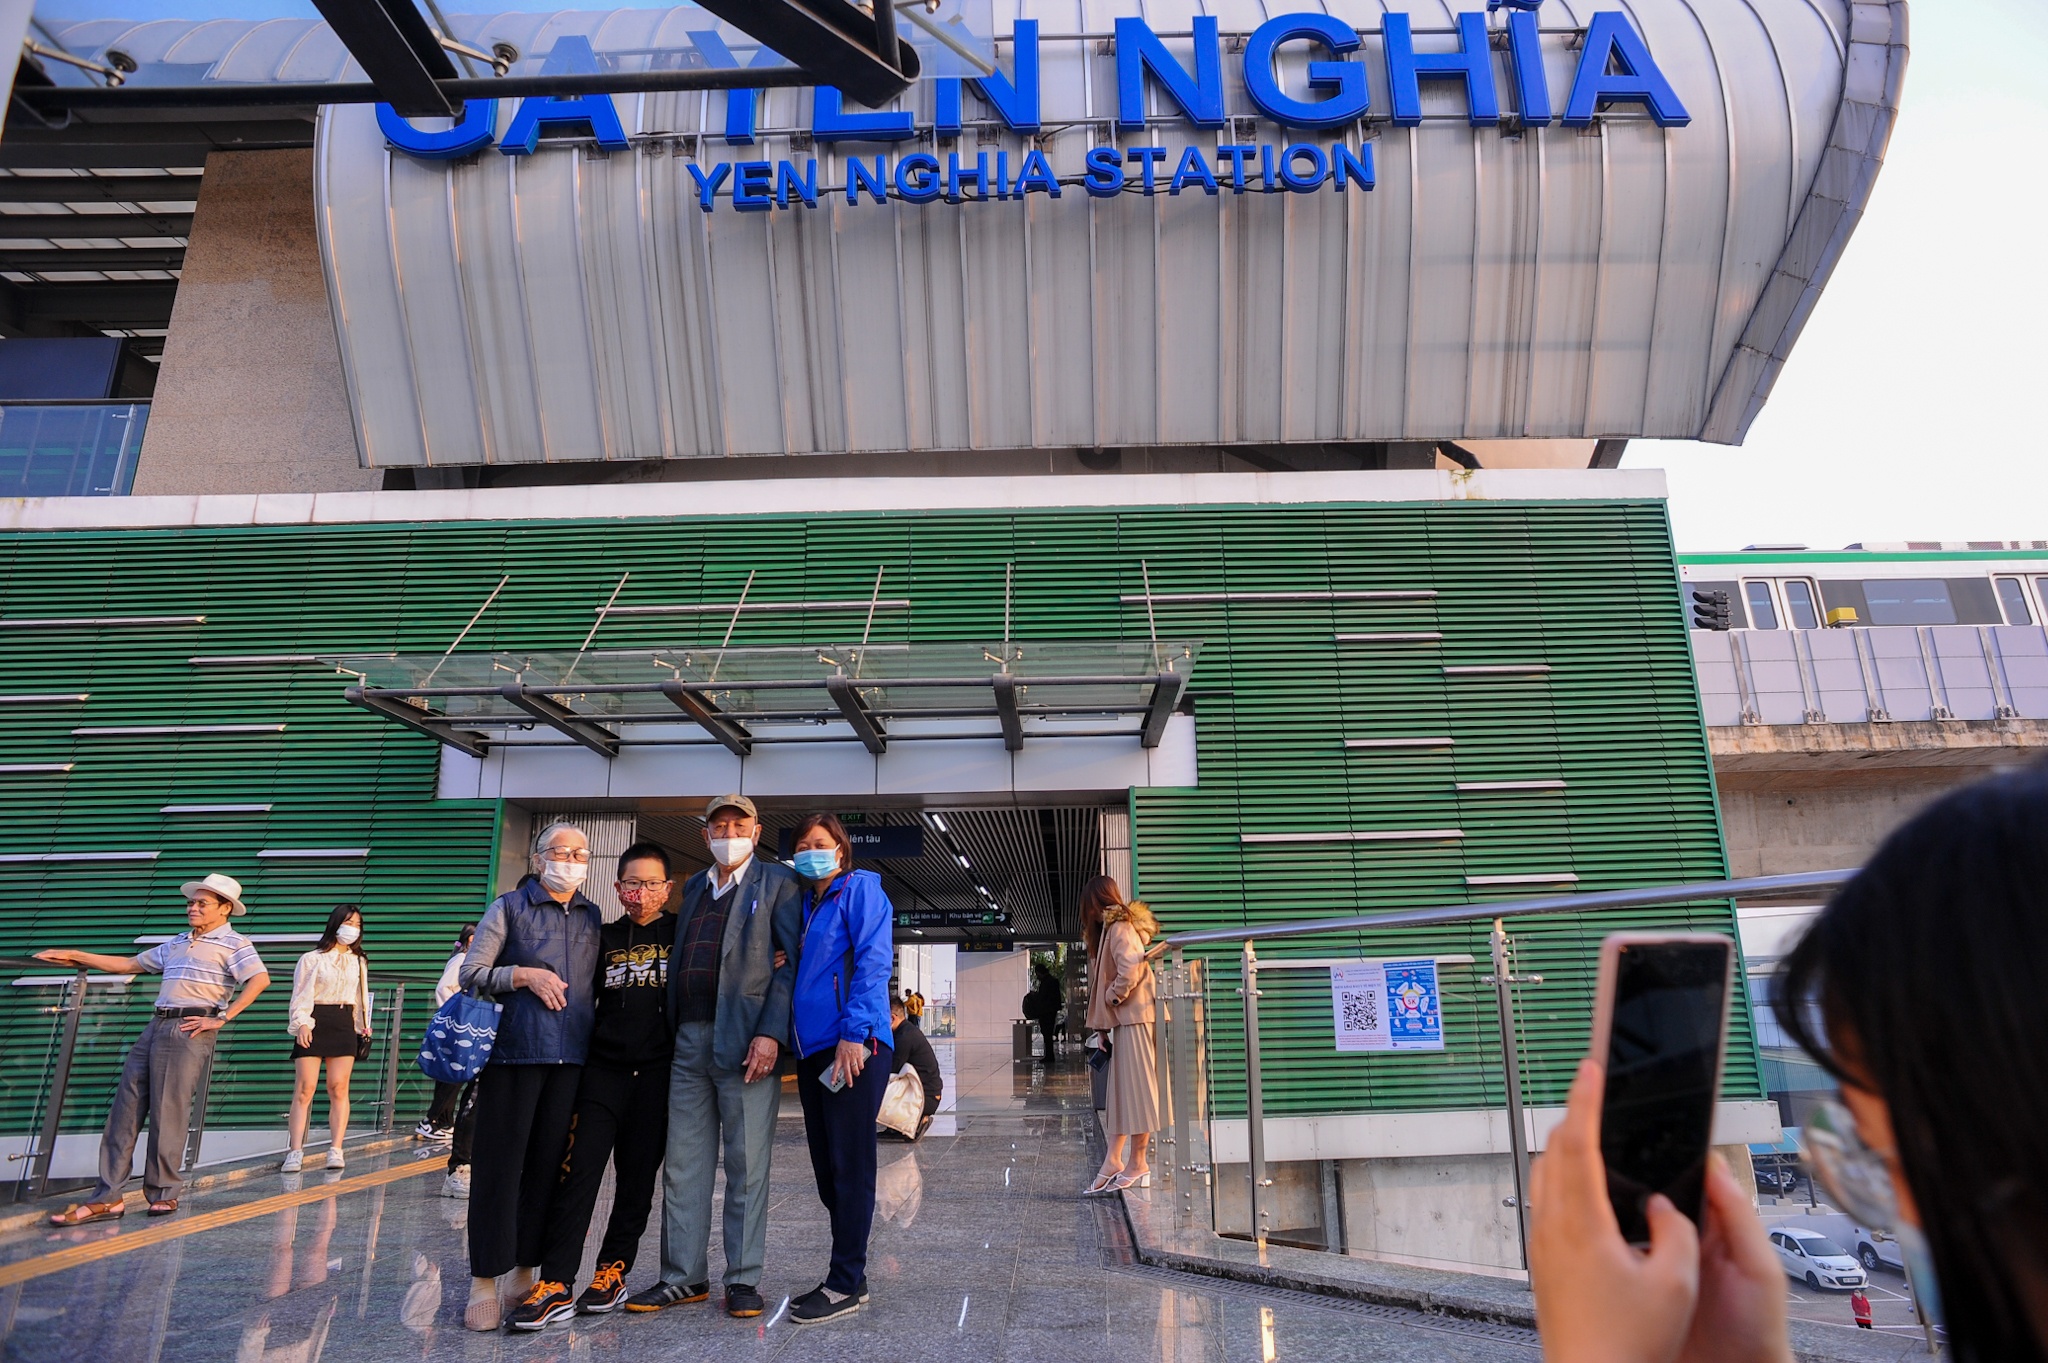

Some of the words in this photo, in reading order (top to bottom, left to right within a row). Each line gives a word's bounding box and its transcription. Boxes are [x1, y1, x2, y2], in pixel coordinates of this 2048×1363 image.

[685, 158, 818, 213] YEN
[846, 150, 1062, 206] NGHIA
[1084, 142, 1376, 199] STATION
[849, 834, 864, 843] lên
[866, 833, 881, 843] tàu
